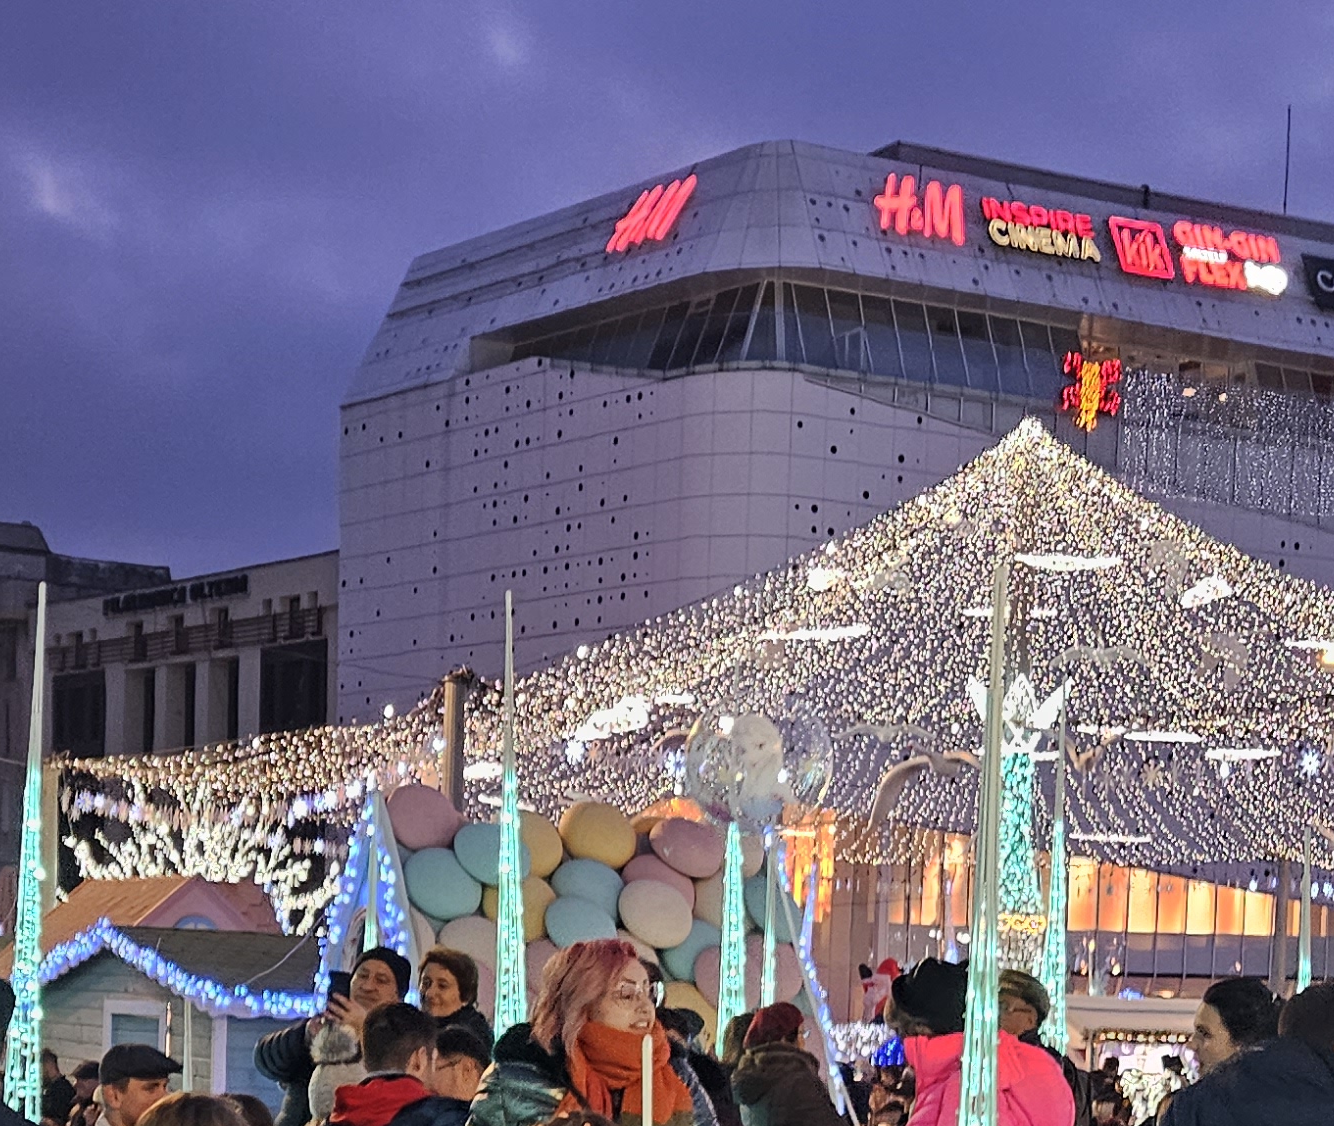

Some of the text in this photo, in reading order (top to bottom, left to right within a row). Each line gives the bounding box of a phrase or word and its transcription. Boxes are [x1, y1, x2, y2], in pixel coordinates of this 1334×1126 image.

[873, 172, 965, 247] H&M
[981, 196, 1095, 240] INSPIRE
[988, 217, 1101, 264] CINEMA
